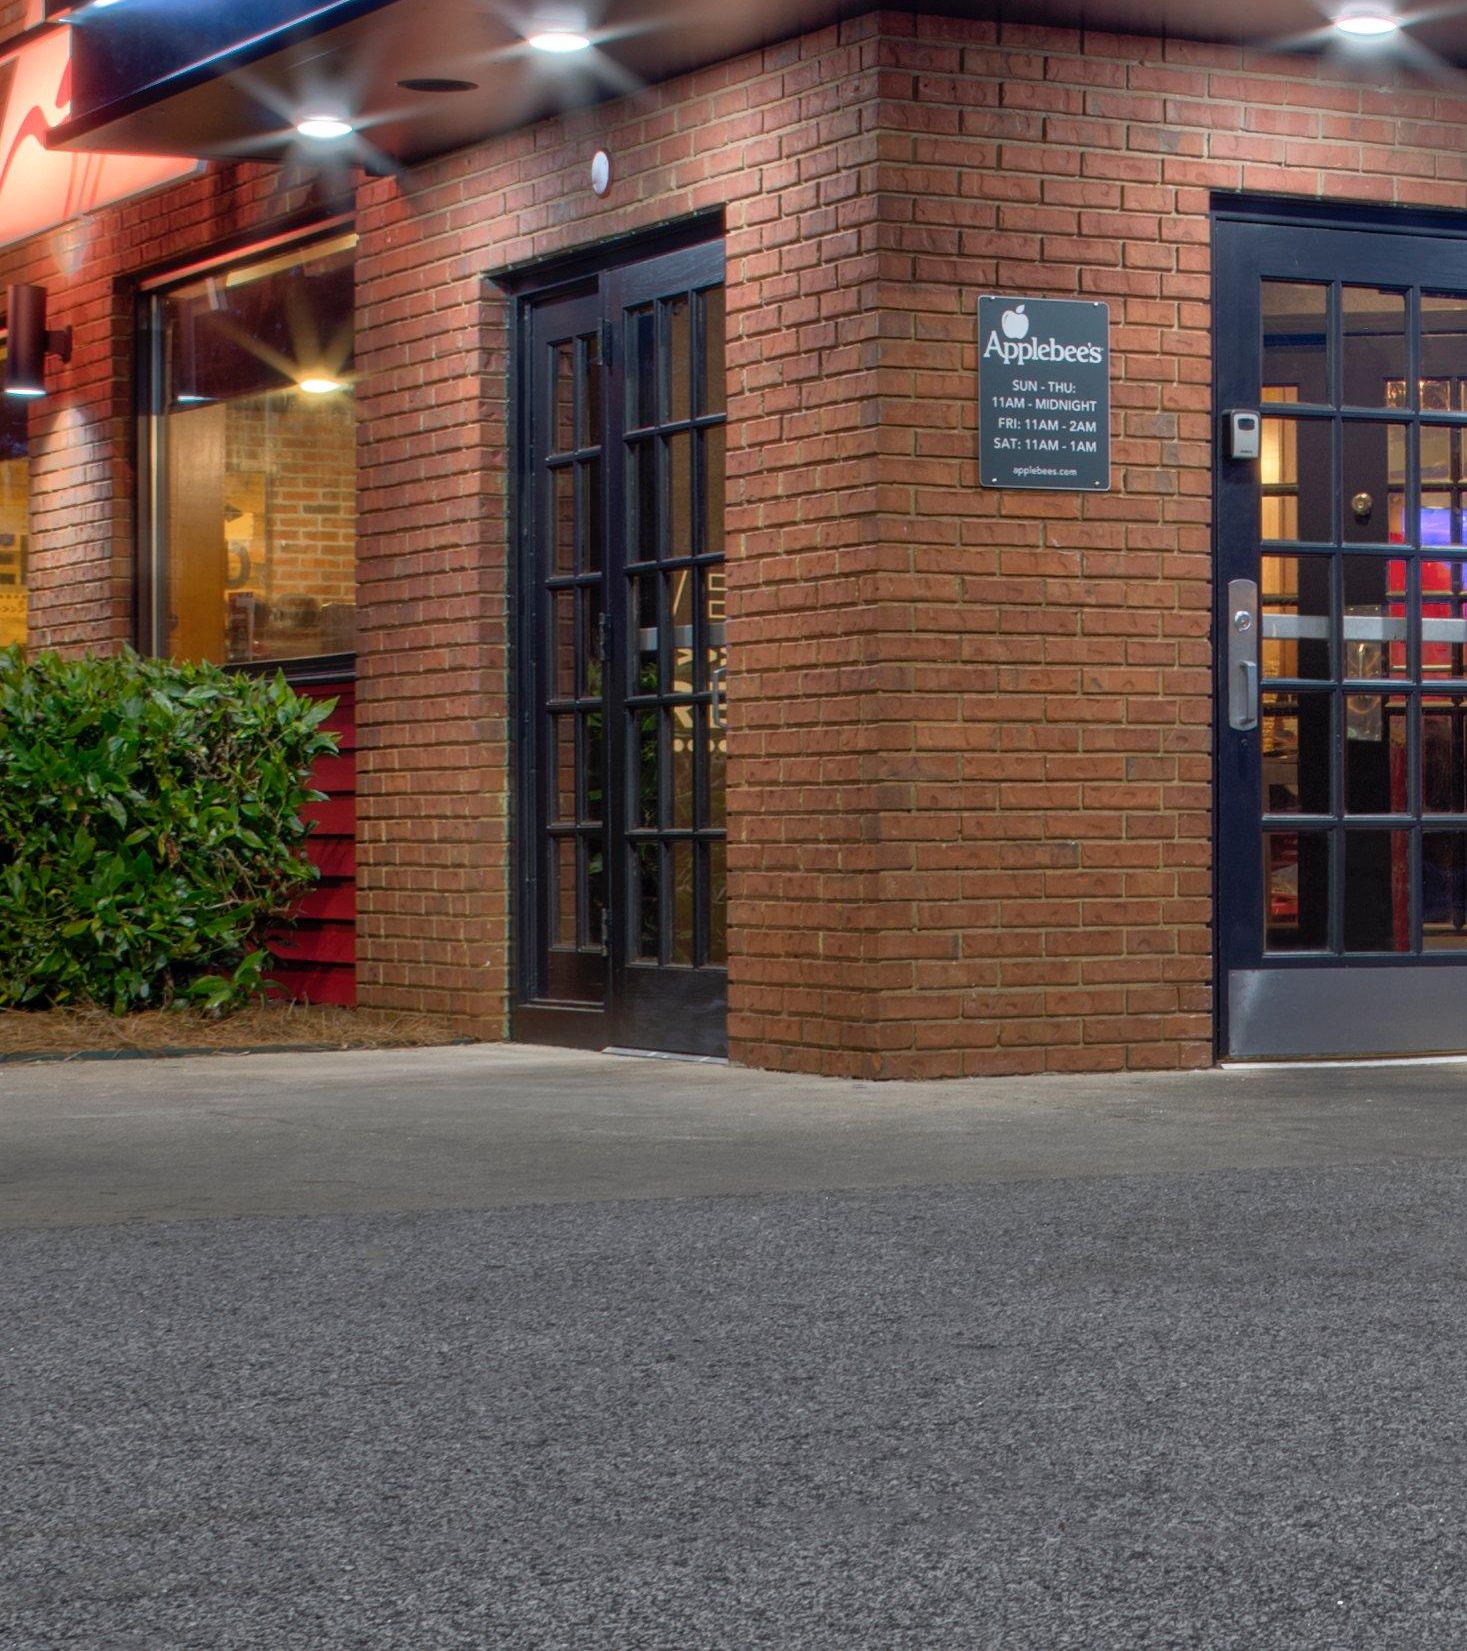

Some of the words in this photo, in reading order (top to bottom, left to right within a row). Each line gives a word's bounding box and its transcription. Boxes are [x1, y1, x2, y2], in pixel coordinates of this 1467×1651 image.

[983, 330, 1102, 365] Applebee's
[1012, 379, 1038, 392] SUN
[1047, 381, 1076, 394] THU:
[992, 396, 1025, 409] 11AM
[1035, 398, 1098, 412] MIDNIGHT
[998, 417, 1021, 430] FRI:
[1025, 418, 1059, 431] 11AM
[1069, 420, 1097, 433] 2AM
[993, 437, 1021, 450] SAT:
[1025, 438, 1059, 451] 11AM
[1070, 440, 1097, 453] 1AM
[1012, 465, 1078, 477] applebees.com
